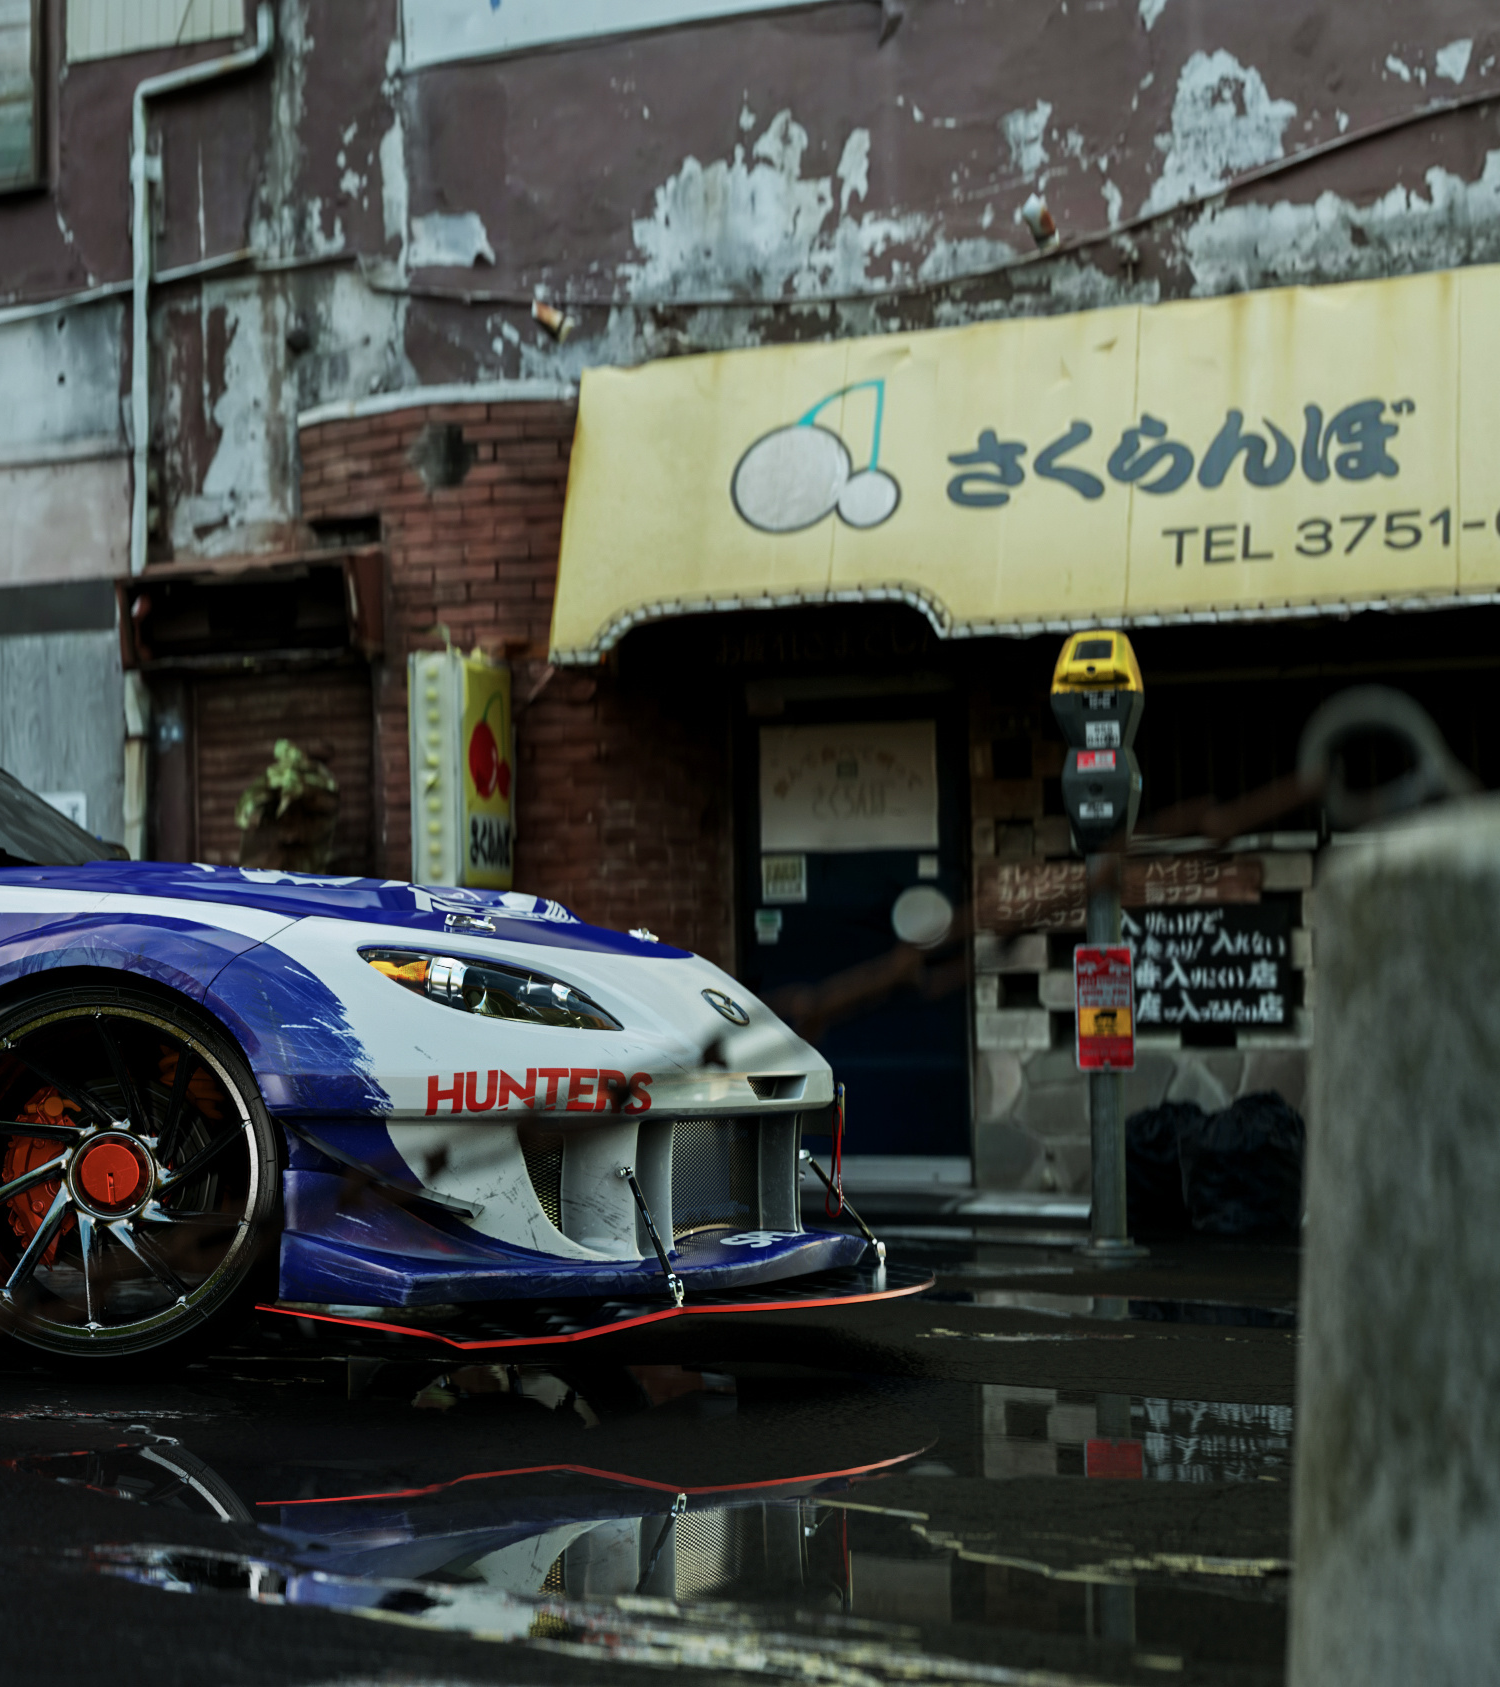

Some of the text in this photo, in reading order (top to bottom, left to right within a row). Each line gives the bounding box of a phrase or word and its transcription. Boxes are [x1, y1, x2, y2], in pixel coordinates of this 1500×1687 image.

[947, 397, 1415, 508] さくらんぼ
[1162, 507, 1500, 567] TEL 3751-
[425, 1067, 654, 1117] HUNTERS
